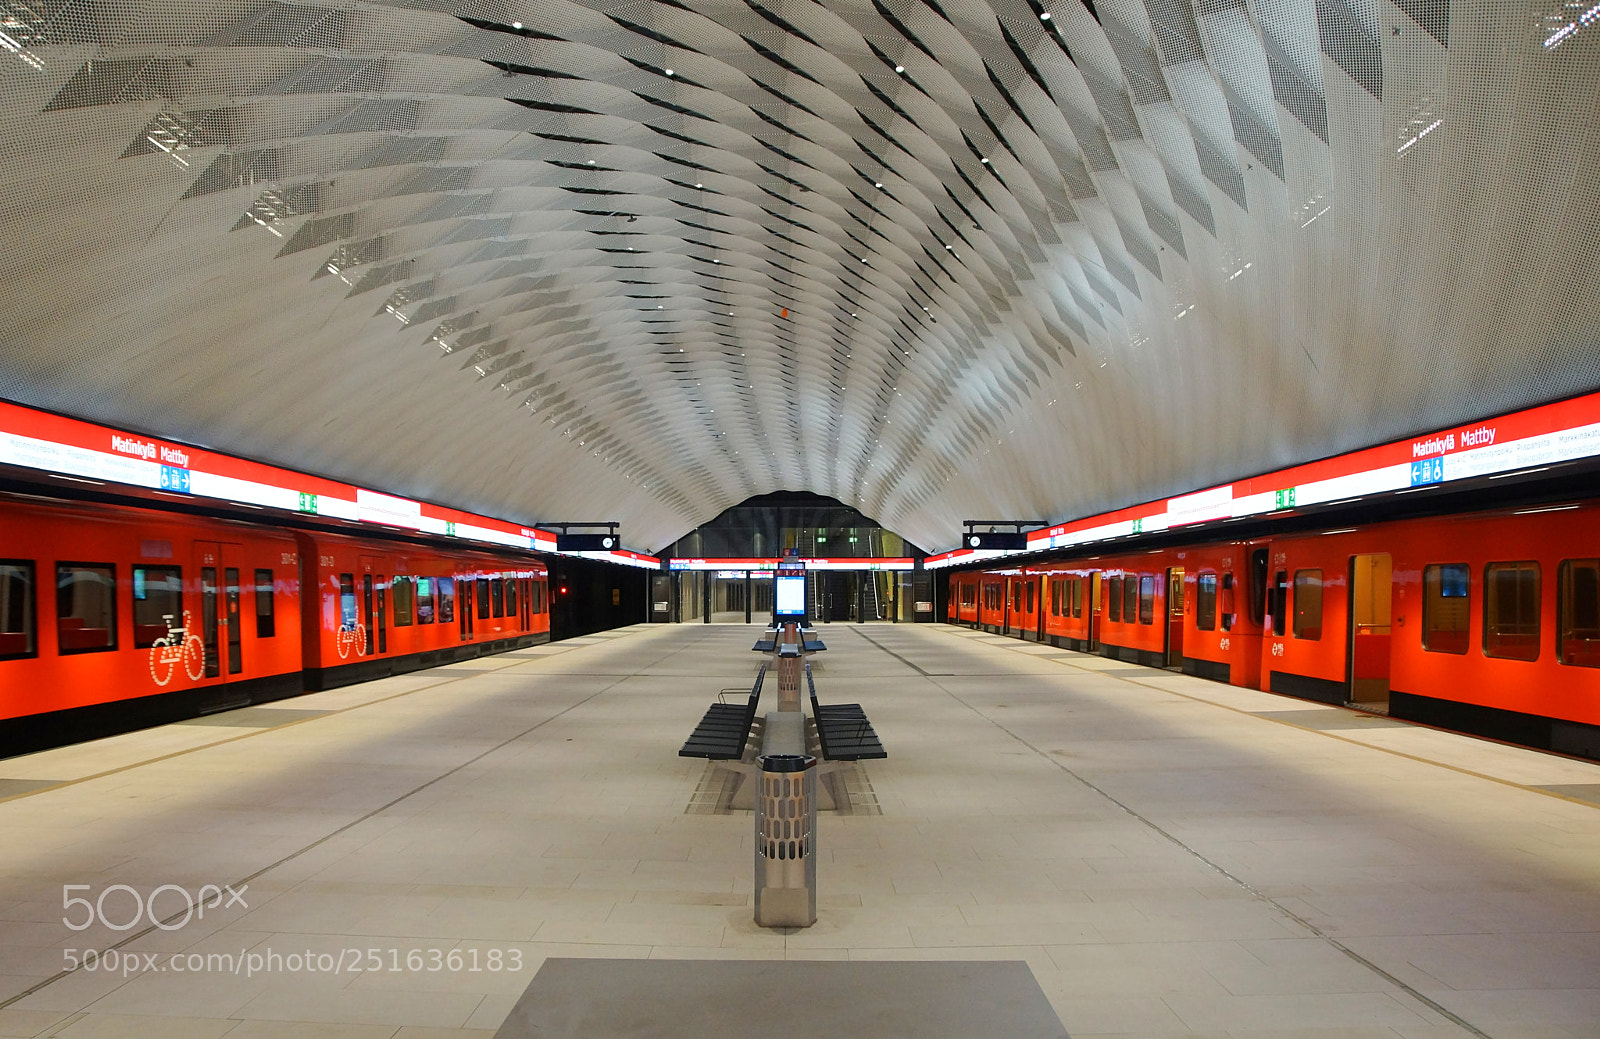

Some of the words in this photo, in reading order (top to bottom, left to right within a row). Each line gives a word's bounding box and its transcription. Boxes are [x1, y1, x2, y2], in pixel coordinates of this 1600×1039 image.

[112, 435, 157, 460] Matinkylä
[160, 446, 189, 468] Mattby
[1413, 435, 1455, 458] Matinkylä
[1461, 426, 1496, 447] Mattby
